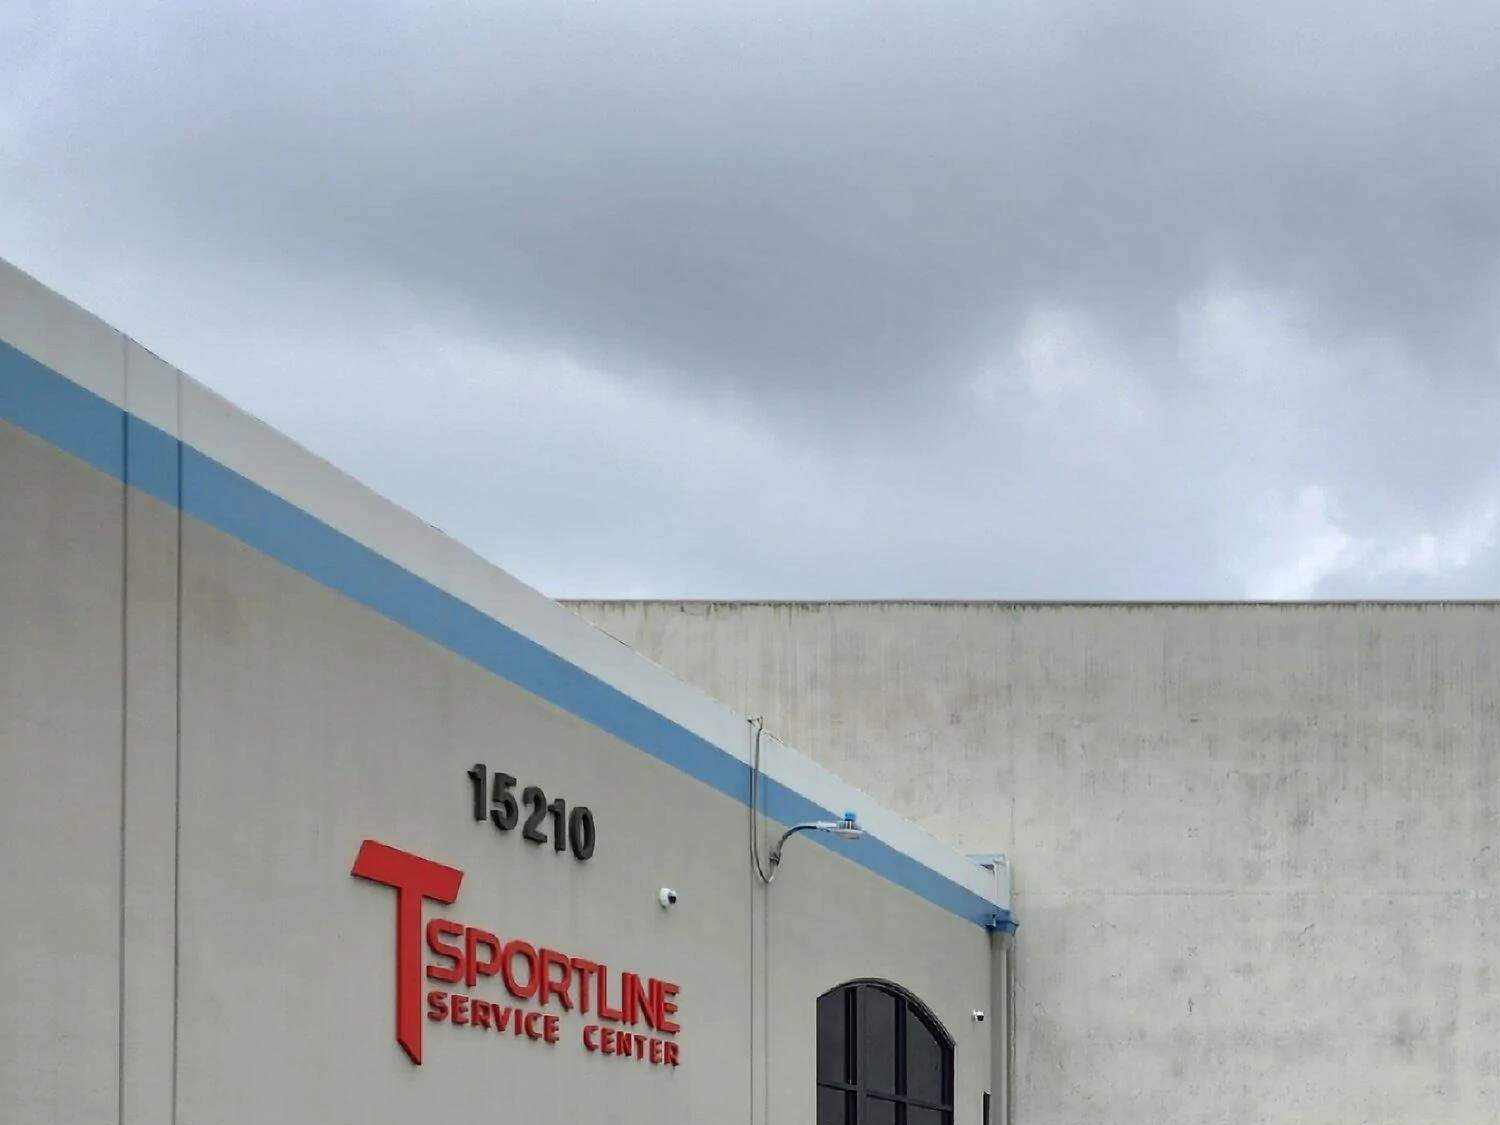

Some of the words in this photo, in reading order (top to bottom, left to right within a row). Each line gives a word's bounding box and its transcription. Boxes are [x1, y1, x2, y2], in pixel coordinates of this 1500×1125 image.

[467, 763, 595, 860] 15210
[427, 991, 559, 1044] SERVICE
[583, 1025, 679, 1067] CENTER
